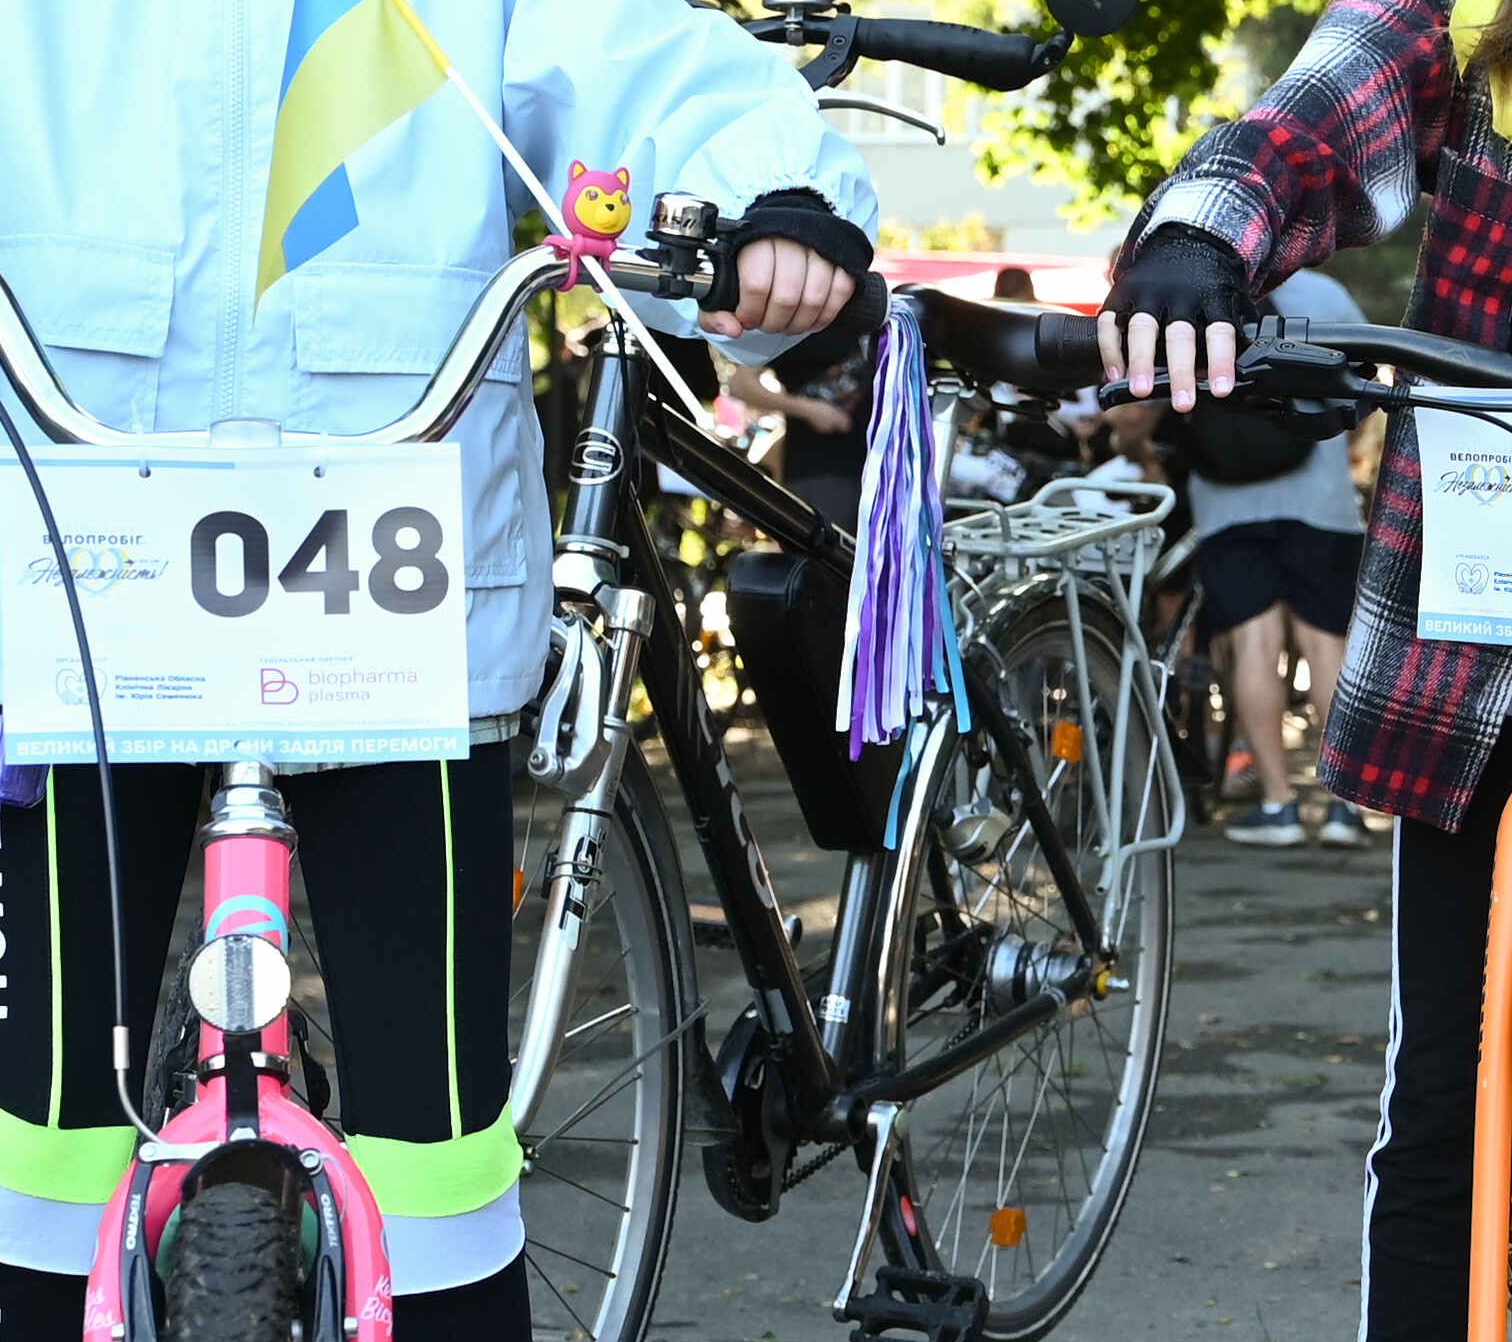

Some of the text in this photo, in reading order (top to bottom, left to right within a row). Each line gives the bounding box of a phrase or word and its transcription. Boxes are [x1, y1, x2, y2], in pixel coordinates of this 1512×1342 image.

[42, 534, 144, 546] ВЛОПРОБІГ
[191, 506, 449, 618] 048
[1424, 618, 1493, 637] ВЕЛИКИЙ
[308, 669, 418, 687] biopharma
[308, 688, 371, 704] plasma
[121, 739, 166, 755] ЗБІР
[171, 739, 200, 754] НА
[279, 738, 345, 755] ЗАДЛЯ
[351, 735, 458, 753] ПЕРЕМОГИ
[125, 1193, 142, 1251] TEKTRO
